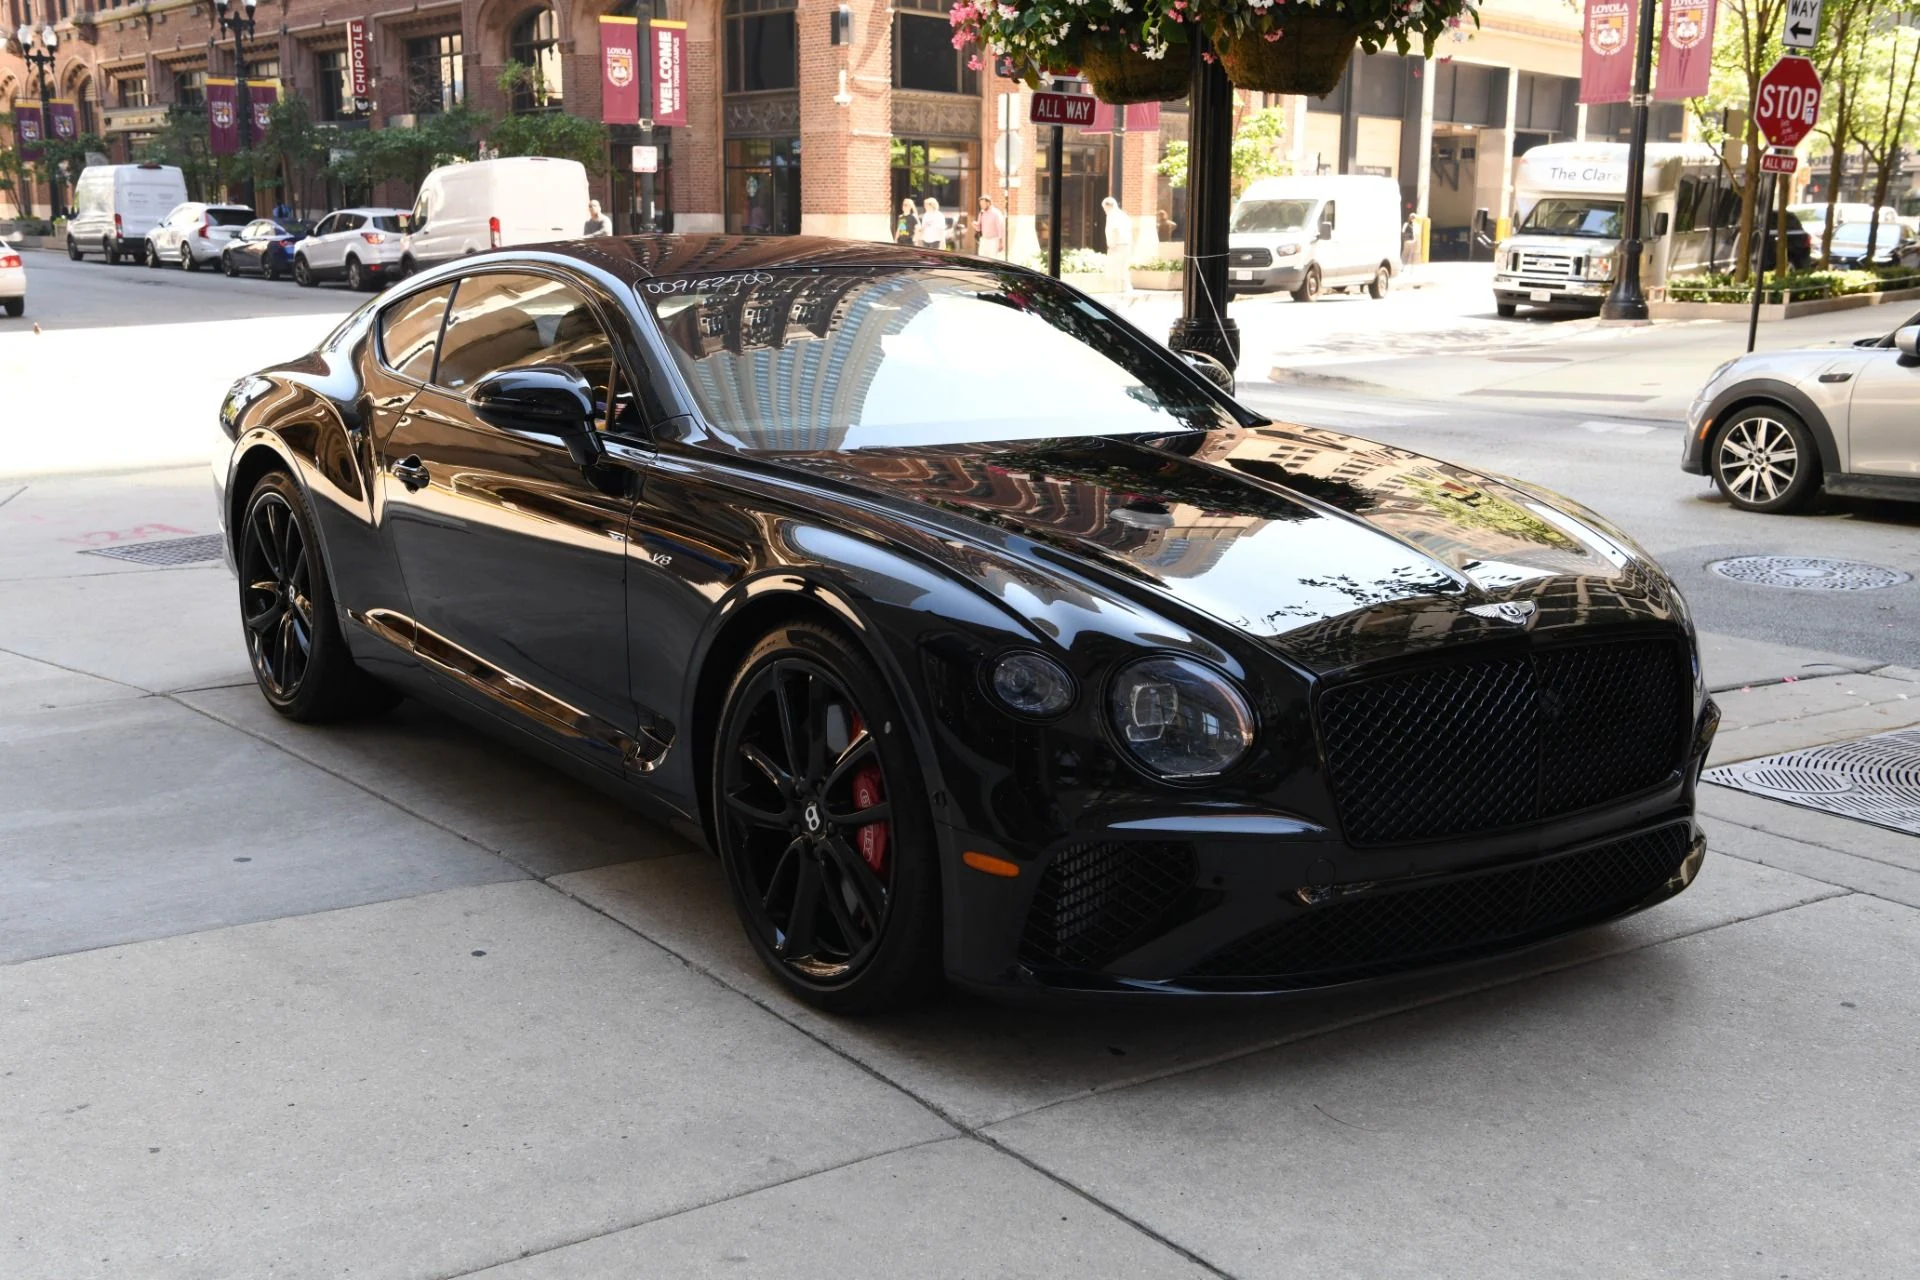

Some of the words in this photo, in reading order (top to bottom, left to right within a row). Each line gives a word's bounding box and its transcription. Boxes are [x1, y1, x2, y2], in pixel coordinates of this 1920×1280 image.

[1591, 3, 1629, 14] LOYOLA
[1791, 0, 1818, 18] WAY
[352, 24, 366, 93] CHIPOTLE
[607, 47, 632, 55] LOYOLA
[658, 31, 673, 114] WELCOME
[1037, 98, 1060, 118] ALL
[1066, 100, 1090, 120] WAY
[1760, 84, 1818, 120] STOP
[1764, 158, 1779, 169] ALL
[1781, 159, 1795, 170] WAY
[1550, 167, 1577, 181] The
[652, 552, 673, 566] V8
